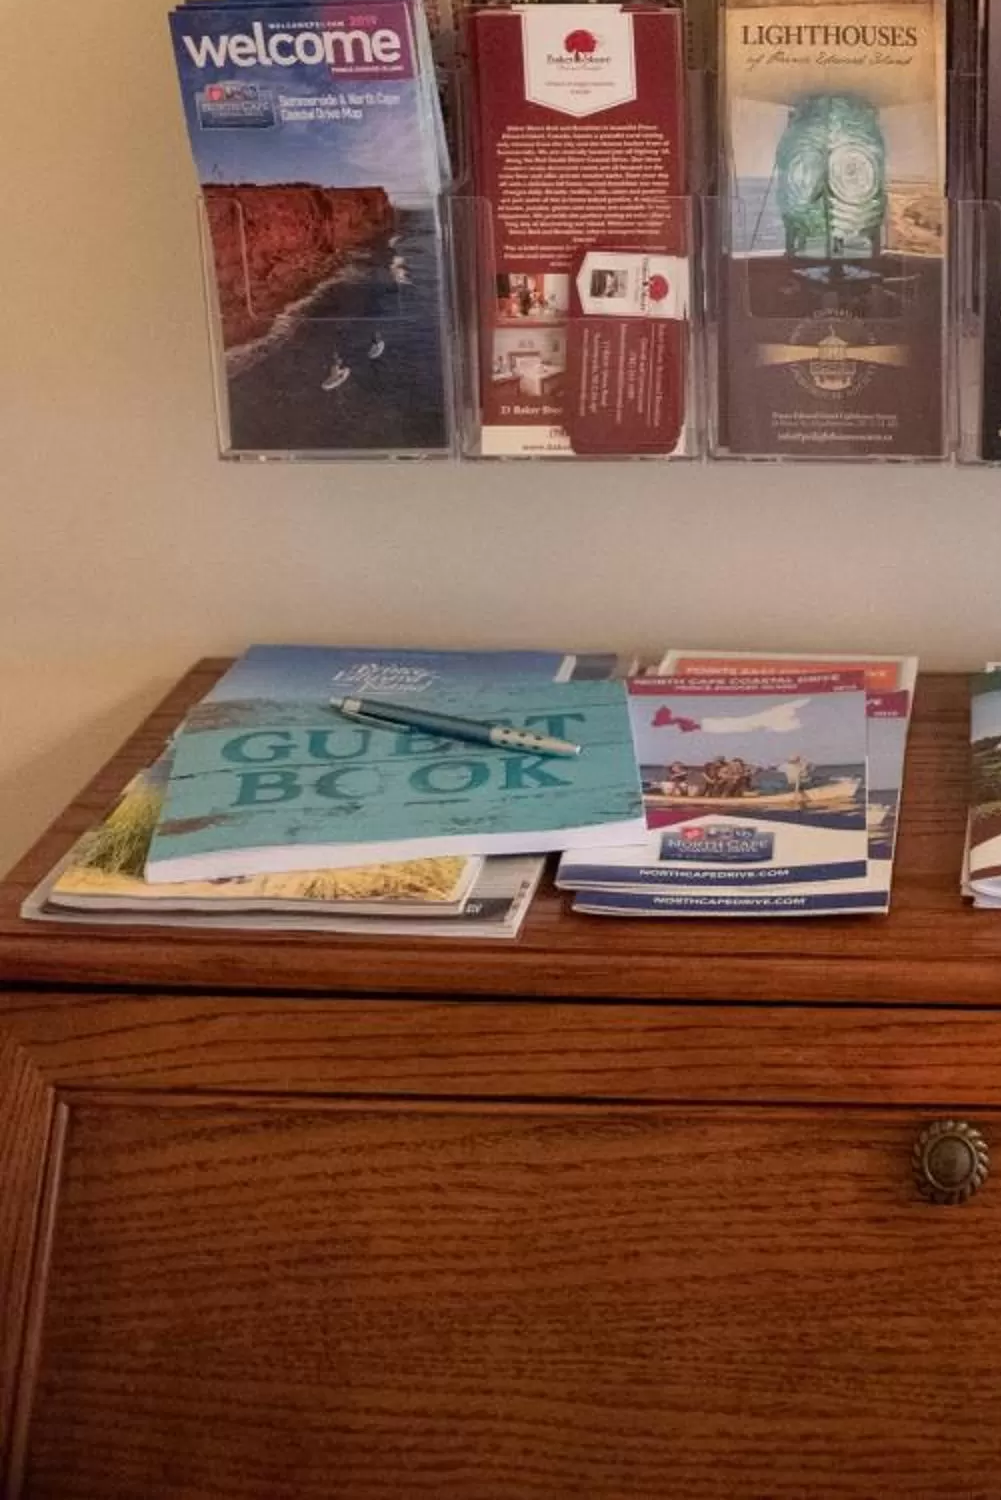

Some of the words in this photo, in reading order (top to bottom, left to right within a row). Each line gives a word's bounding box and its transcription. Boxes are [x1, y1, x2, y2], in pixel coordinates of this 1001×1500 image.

[742, 25, 918, 47] LIGHTHOUSES
[183, 21, 401, 68] welcome
[343, 108, 363, 121] Map
[633, 678, 685, 687] NORTH
[688, 677, 726, 686] CAPE
[729, 675, 793, 685] COASTAL
[230, 756, 575, 807] BOOK
[668, 839, 724, 849] NORTH
[728, 838, 770, 849] CAPE
[639, 869, 790, 880] NORTHCAPEDRIVE.COM
[653, 896, 808, 906] NORTHCAPEDRIVE.COM
